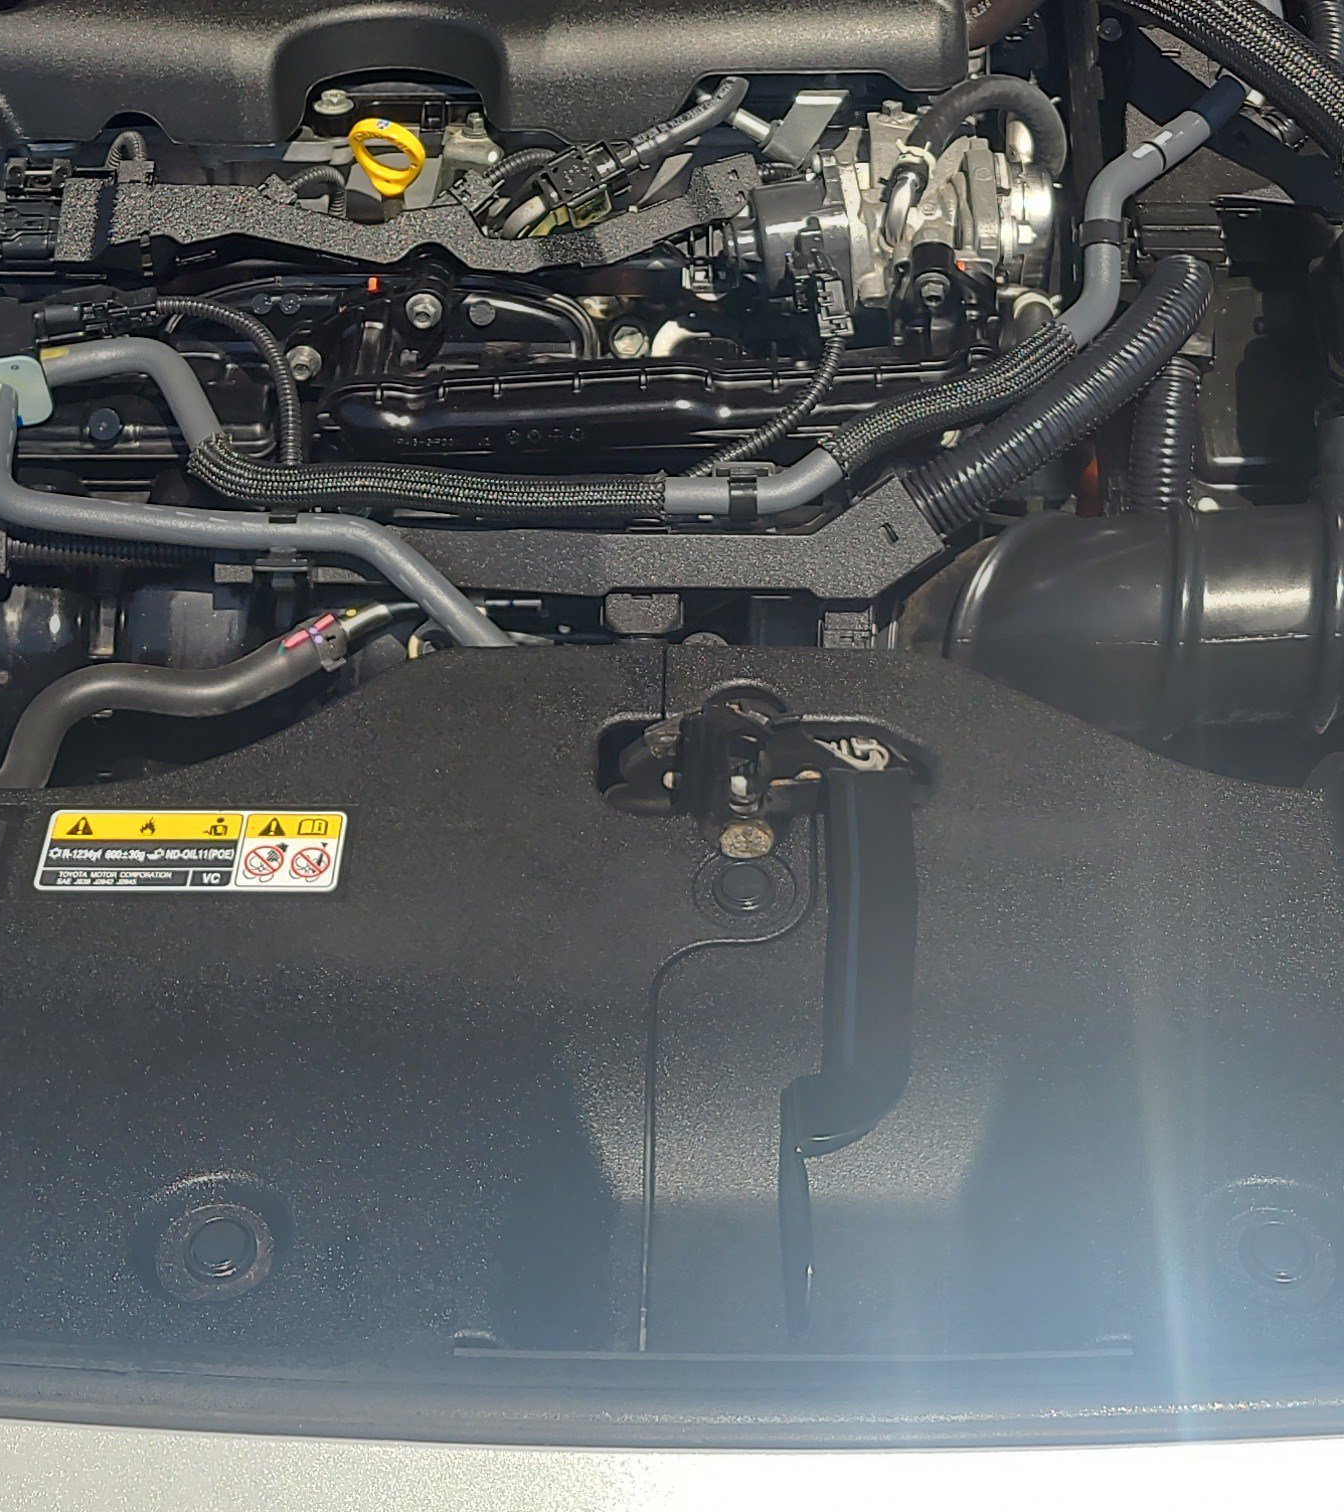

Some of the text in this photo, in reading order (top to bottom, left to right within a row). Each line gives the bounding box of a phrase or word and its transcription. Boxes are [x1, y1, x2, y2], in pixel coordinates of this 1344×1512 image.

[58, 870, 87, 878] TOYOTA
[119, 871, 173, 879] CORPORATION
[202, 872, 221, 884] VC
